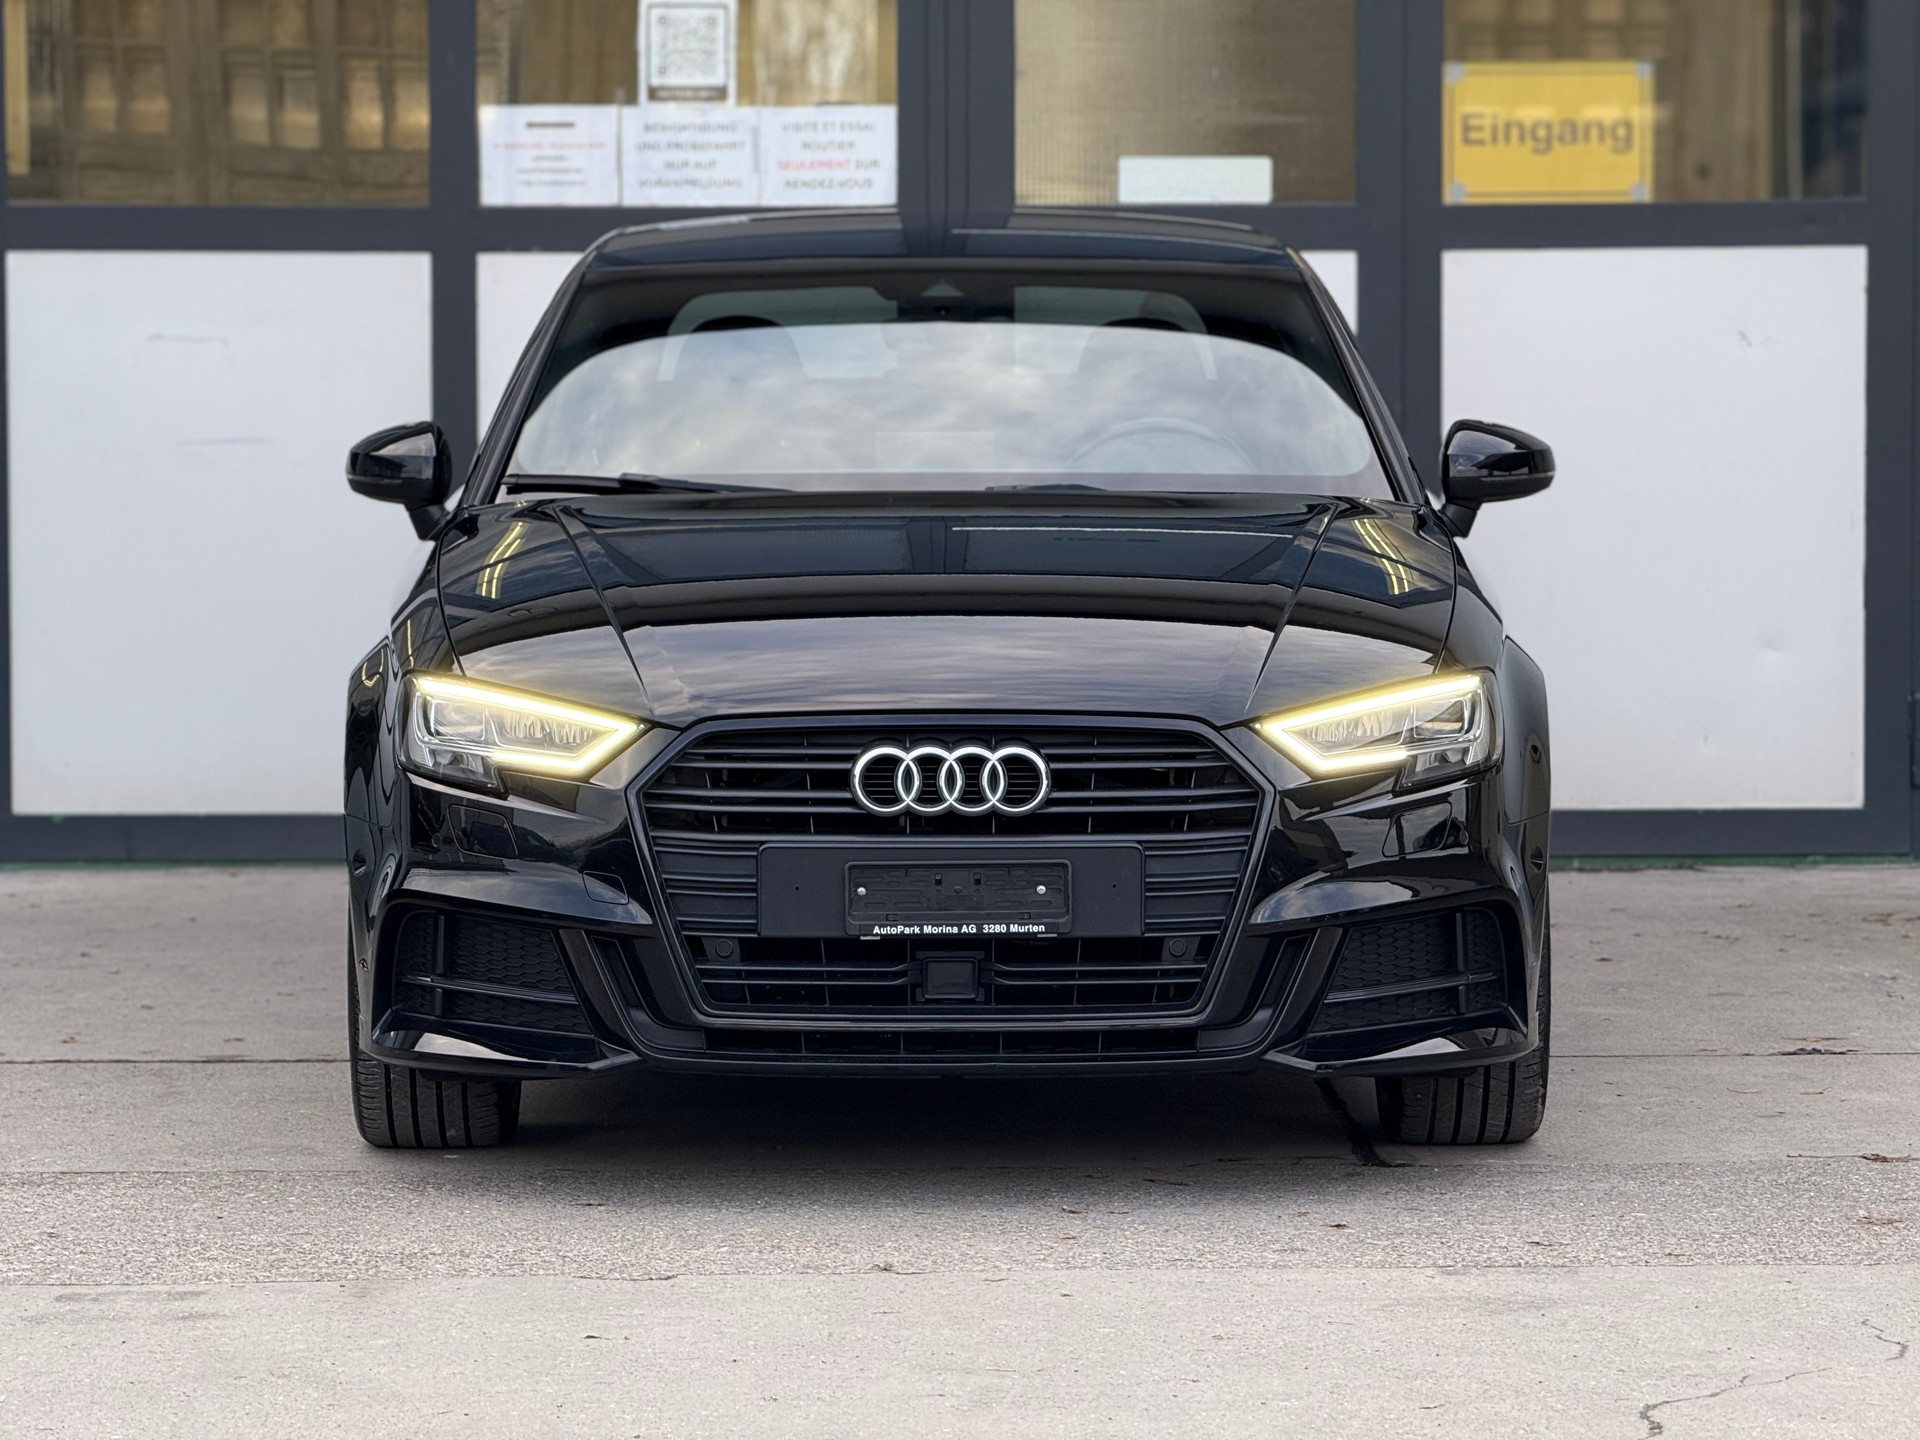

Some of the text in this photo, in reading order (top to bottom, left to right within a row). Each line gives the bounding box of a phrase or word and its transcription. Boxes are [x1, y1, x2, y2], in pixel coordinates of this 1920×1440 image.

[782, 121, 818, 133] VISITE
[822, 121, 836, 133] ET
[1460, 112, 1634, 155] Eingang
[800, 140, 856, 152] ROUTIER
[777, 159, 881, 171] SEULEMENT SUR
[783, 177, 874, 189] RENDEZ-VOUS
[872, 923, 1046, 935] AutoPark Morina AG 3280 Murten
